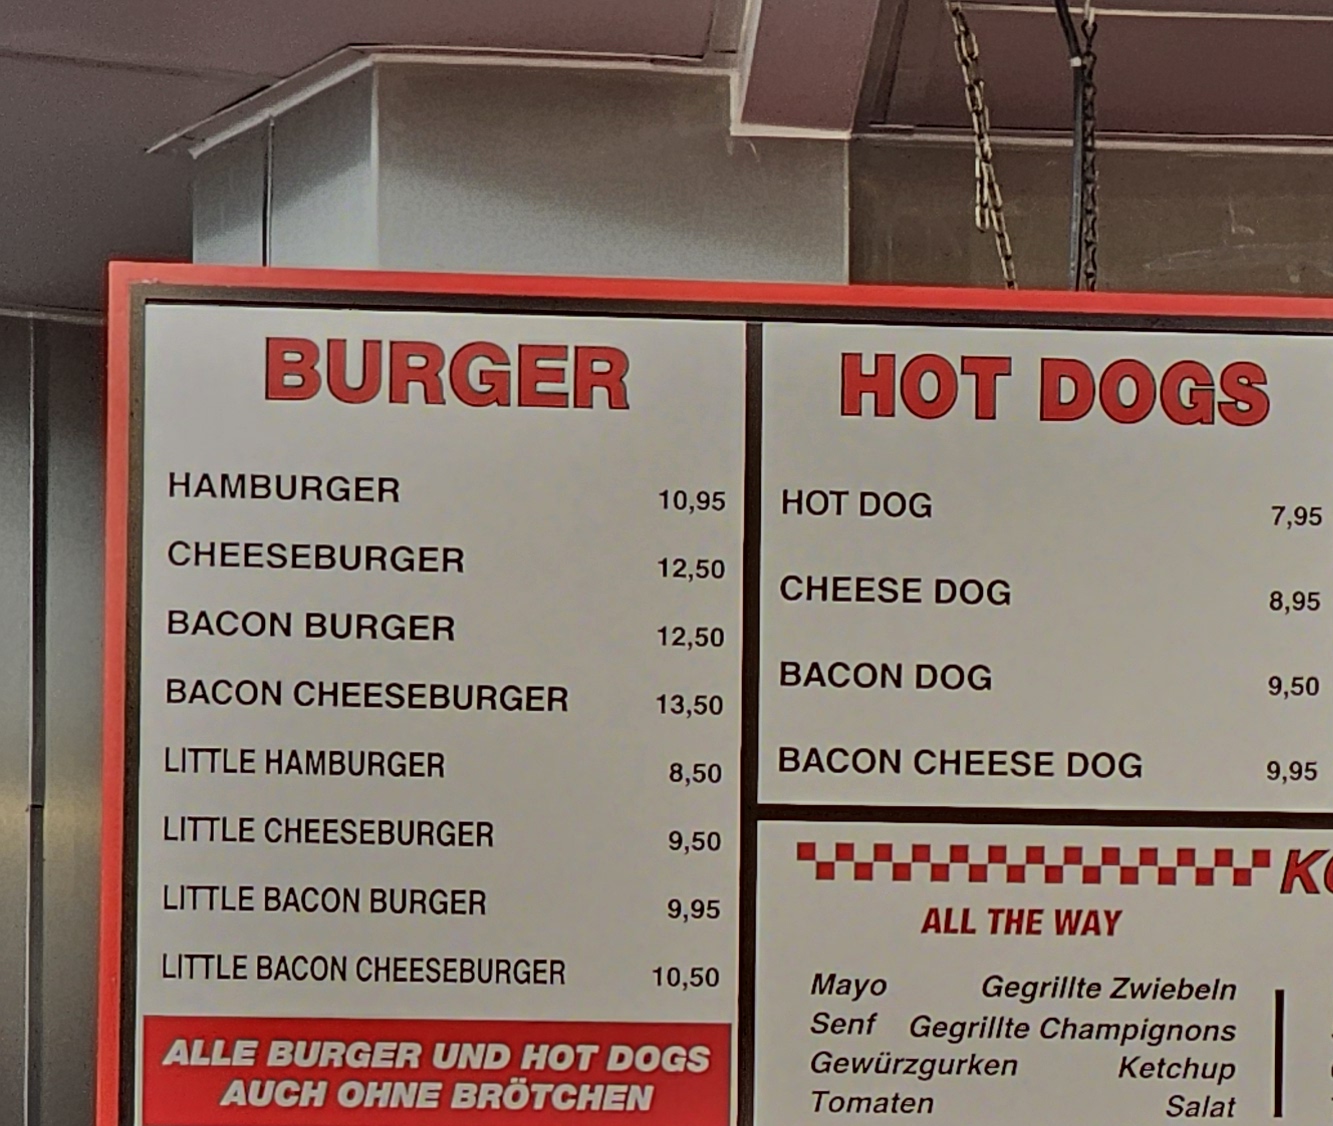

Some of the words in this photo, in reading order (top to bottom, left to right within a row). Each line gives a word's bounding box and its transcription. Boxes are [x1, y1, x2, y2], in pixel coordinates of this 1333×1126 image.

[265, 337, 629, 410] BURGER
[841, 353, 1011, 420] HOT
[1040, 358, 1270, 426] DOGS
[170, 472, 399, 502] HAMBURGER
[659, 490, 725, 513] 10,95
[783, 489, 849, 515] HOT
[860, 492, 931, 518] DOG
[1272, 506, 1322, 529] 7,95
[168, 541, 463, 572] CHEESEBURGER
[658, 558, 725, 582] 12,50
[780, 575, 921, 603] CHEESE
[935, 579, 1010, 605] DOG
[1270, 591, 1320, 614] 8,95
[167, 679, 281, 706] BACON
[294, 681, 567, 711] CHEESEBURGER
[657, 694, 722, 718] 13,50
[780, 661, 902, 688] BACON
[916, 664, 991, 690] DOG
[1269, 676, 1319, 699] 9,50
[164, 816, 255, 842] LITTLE
[265, 818, 493, 847] CHEESEBURGER
[669, 831, 721, 854] 9,50
[164, 885, 254, 911] LITTLE
[265, 887, 359, 912] BACON
[371, 889, 485, 915] BURGER
[668, 899, 720, 922] 9,95
[921, 908, 976, 934] ALL
[988, 908, 1044, 935] THE
[1055, 909, 1122, 936] WAY
[811, 973, 887, 1001] Mayo
[982, 975, 1101, 1004] Gegrillte
[1110, 977, 1236, 1000] Zwiebeln
[162, 1038, 260, 1066] ALLE
[267, 1038, 422, 1068] BURGER
[432, 1042, 510, 1069] UND
[520, 1043, 599, 1070] HOT
[605, 1044, 710, 1072] DOGS
[811, 1051, 1017, 1081] Gewürzgurken
[1119, 1056, 1235, 1085] Ketchup
[219, 1078, 329, 1107] AUCH
[338, 1079, 442, 1108] OHNE
[451, 1076, 654, 1110] BRÖTCHEN
